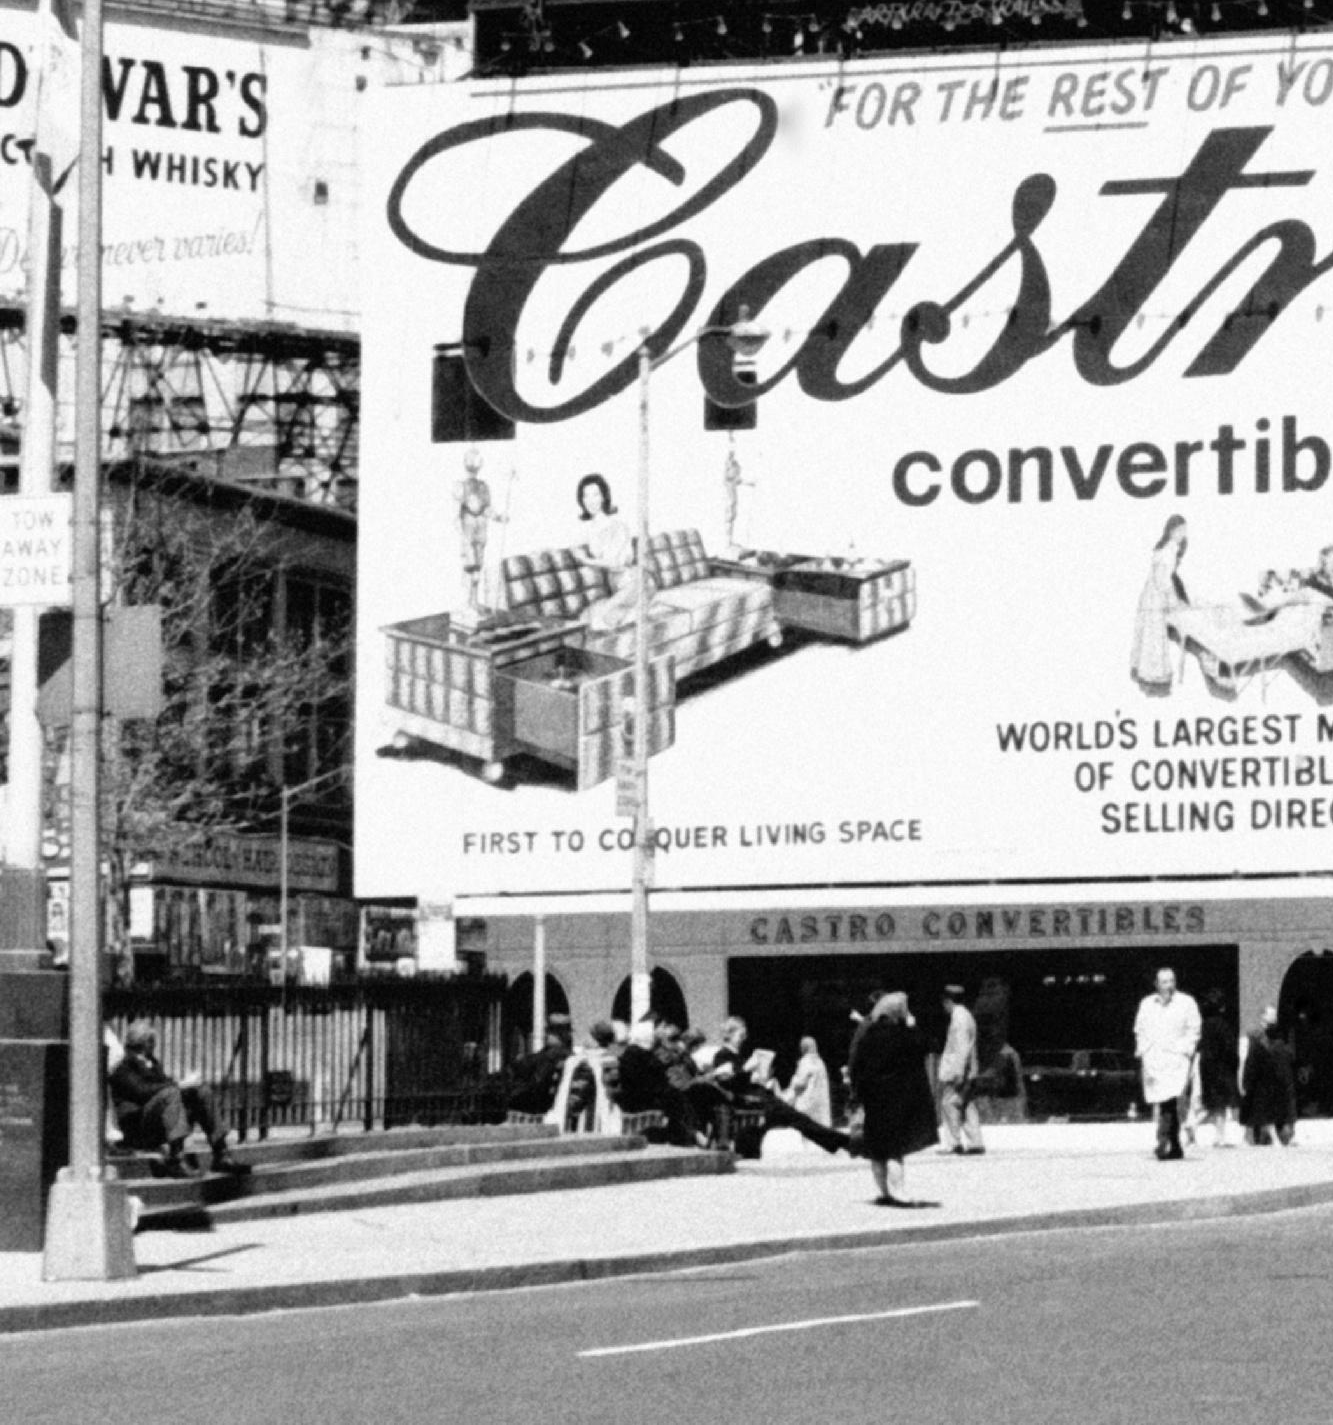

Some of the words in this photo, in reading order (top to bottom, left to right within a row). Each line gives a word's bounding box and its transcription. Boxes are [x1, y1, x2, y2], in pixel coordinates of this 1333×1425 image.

[936, 74, 1031, 123] THE
[1048, 66, 1169, 118] REST
[1187, 62, 1252, 113] OF
[132, 147, 265, 193] WHISKY
[12, 511, 53, 531] TOW
[4, 538, 62, 557] AWAY
[3, 565, 62, 587] ZONE
[996, 710, 1138, 753] WORLD'S
[1153, 713, 1302, 749] LARGEST
[1075, 760, 1114, 792] OF
[1101, 800, 1235, 835] SELLING
[463, 830, 536, 855] FIRST
[551, 829, 585, 853] TO
[598, 825, 729, 854] COQUER
[739, 821, 826, 848] LIVING
[839, 818, 922, 844] SPACE
[750, 912, 897, 945] CASTRO
[921, 906, 1206, 942] CONVERTIBLES
